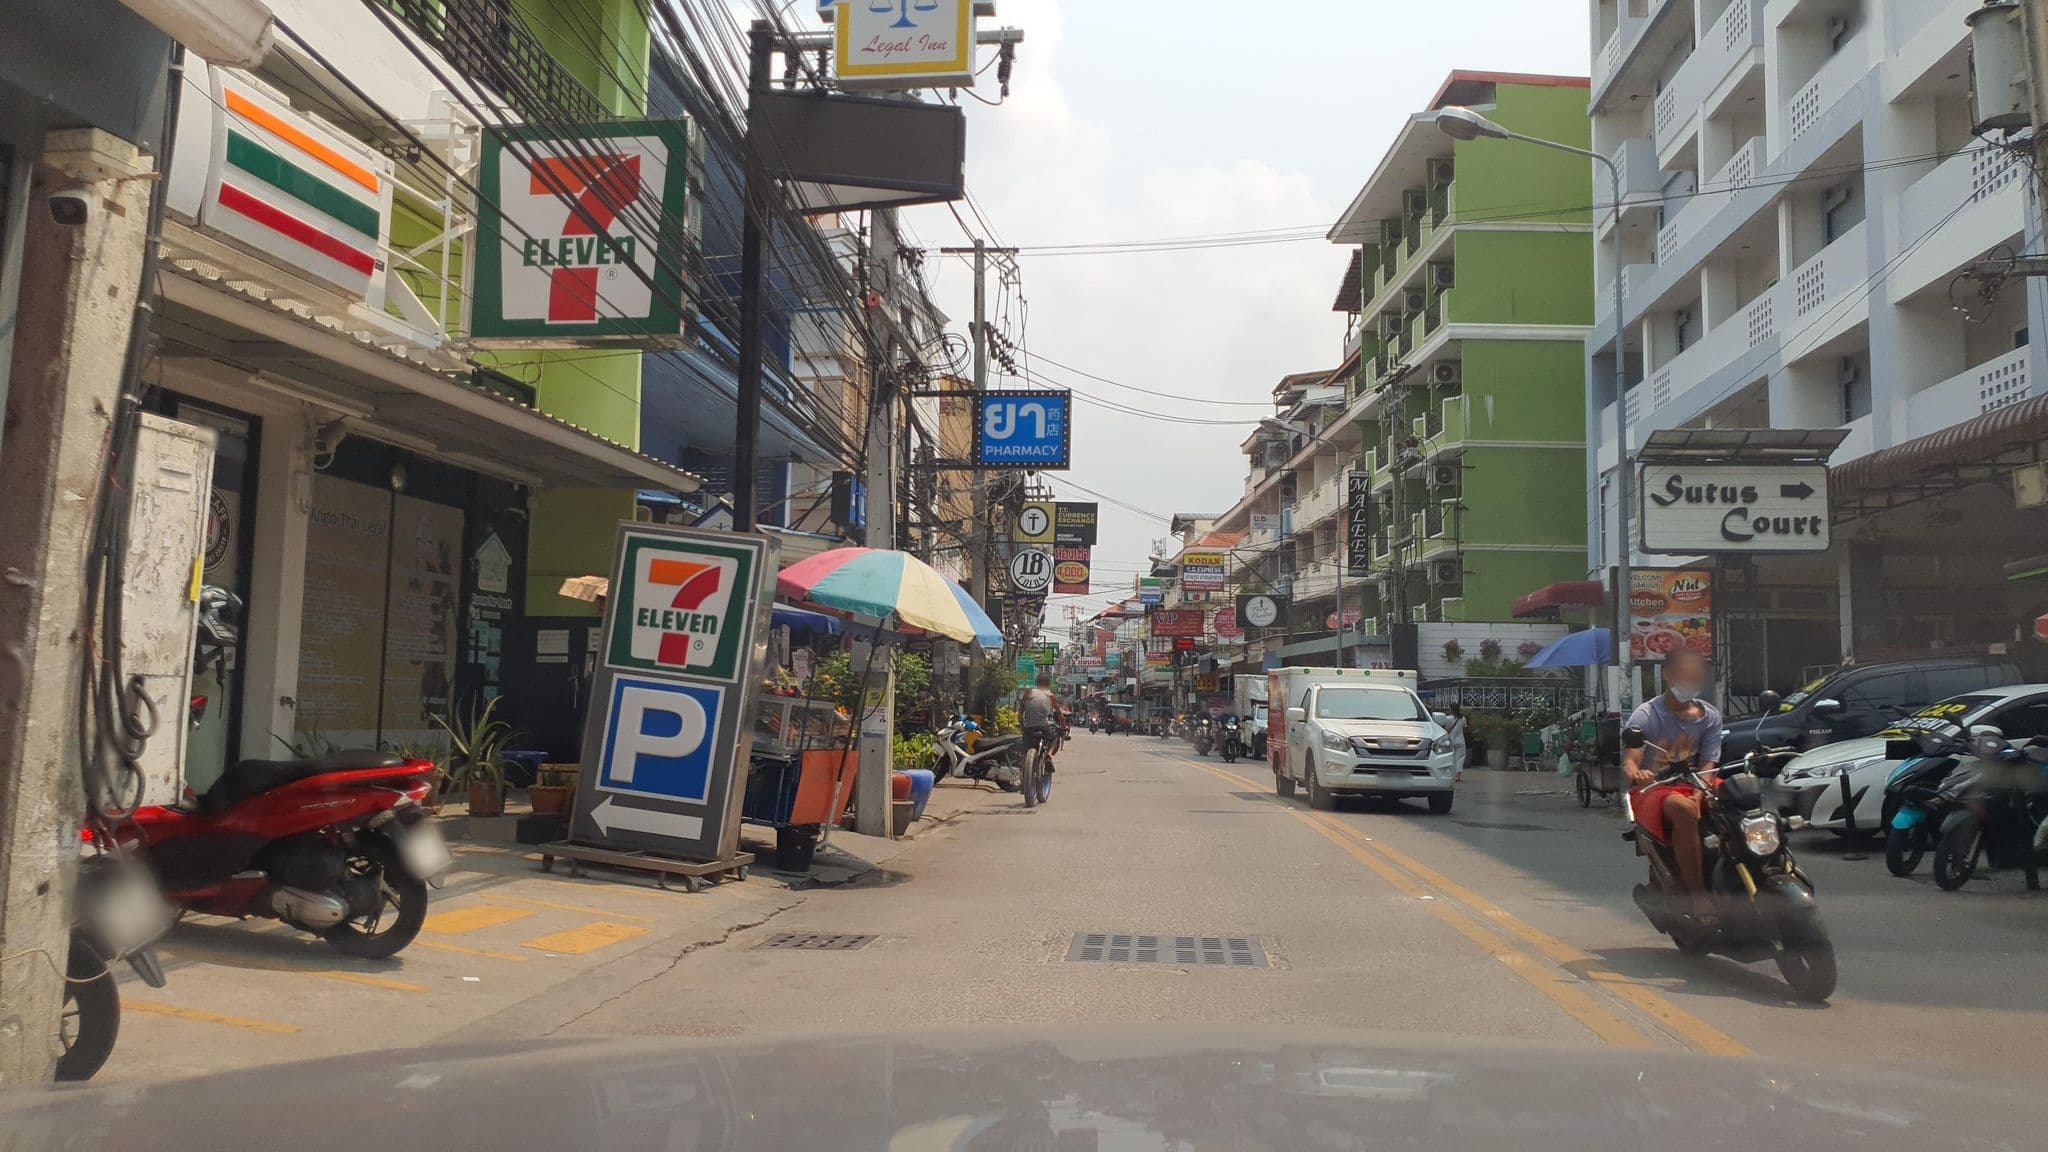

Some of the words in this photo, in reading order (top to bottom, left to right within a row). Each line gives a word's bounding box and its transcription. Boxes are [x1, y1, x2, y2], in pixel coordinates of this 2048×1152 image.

[861, 34, 913, 58] Legal
[918, 34, 949, 51] Inn
[984, 402, 1046, 440] ยา
[985, 445, 1059, 456] PHARMACY
[1651, 474, 1759, 506] Sutus
[1720, 506, 1822, 542] Court
[648, 558, 722, 666] 7
[609, 686, 707, 783] P
